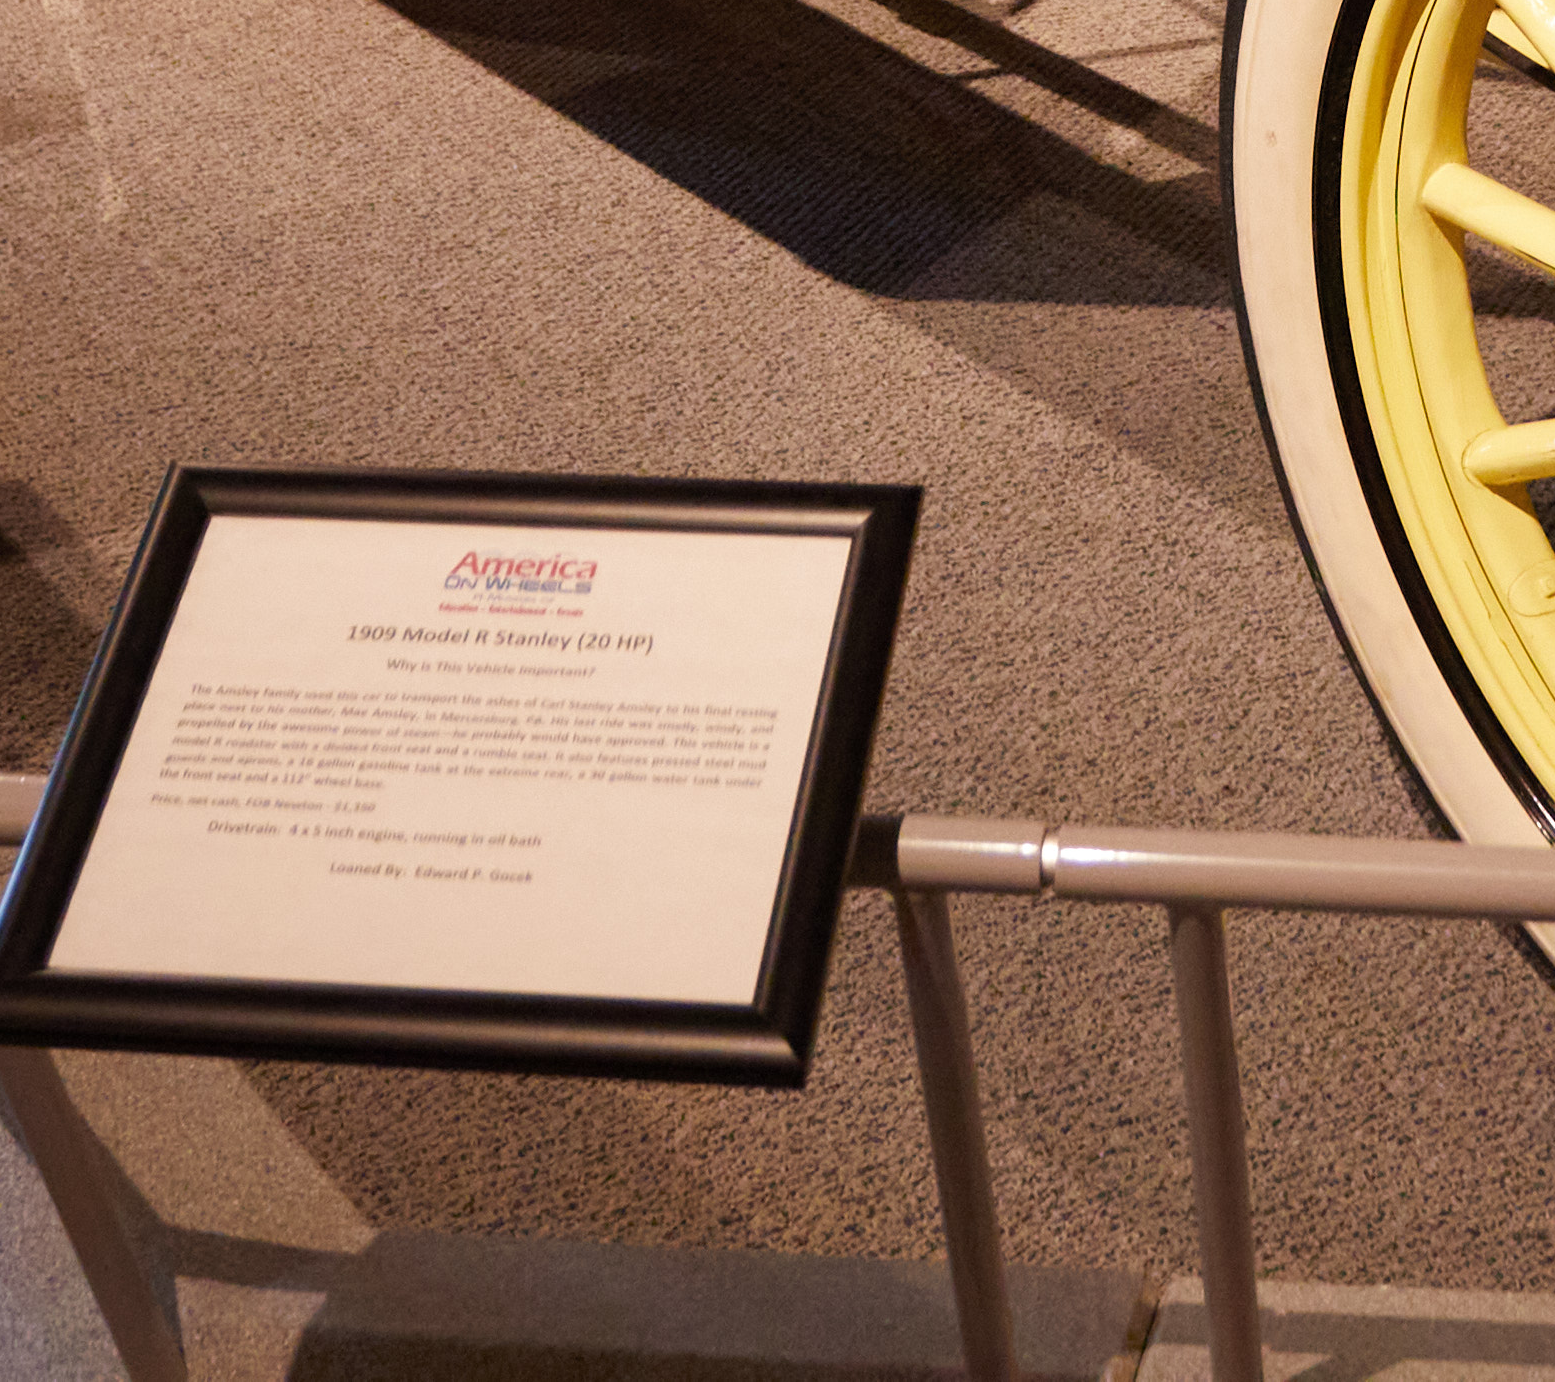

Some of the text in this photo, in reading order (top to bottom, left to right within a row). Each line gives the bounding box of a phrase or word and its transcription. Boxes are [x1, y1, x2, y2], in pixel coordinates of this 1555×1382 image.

[452, 549, 600, 579] America
[443, 574, 593, 594] ON WHEELS
[349, 624, 654, 655] 1909 Model R Stanley (20 HP)
[385, 658, 417, 673] Why
[437, 660, 463, 672] This
[466, 661, 516, 674] Vehicle
[191, 683, 213, 694] The
[262, 686, 301, 700] family
[337, 689, 359, 700] this
[400, 691, 458, 707] transport
[461, 694, 482, 705] the
[486, 695, 521, 707] ashes
[704, 704, 733, 716] final
[182, 699, 216, 713] place
[220, 700, 247, 712] next
[267, 702, 285, 714] his
[629, 720, 652, 729] was
[751, 722, 774, 734] and
[176, 715, 236, 731] propelled
[257, 719, 278, 730] the
[282, 723, 339, 733] awesome
[471, 728, 526, 743] probably
[531, 730, 569, 743] would
[572, 732, 602, 744] have
[674, 736, 697, 748] This
[702, 737, 745, 750] vehicle
[172, 733, 212, 745] model
[226, 735, 277, 748] roadster
[281, 737, 309, 749] with
[324, 739, 369, 752] divided
[371, 741, 402, 753] front
[406, 742, 431, 755] seat
[435, 744, 459, 756] and
[705, 755, 735, 768] steel
[159, 767, 180, 778] the
[182, 768, 214, 780] front
[216, 769, 243, 781] seat
[245, 770, 269, 782] and
[314, 773, 352, 786] wheel
[211, 752, 234, 764] and
[316, 756, 355, 772] gallon
[358, 758, 410, 774] gasoline
[415, 761, 442, 773] tank
[463, 763, 484, 775] the
[489, 764, 540, 777] extreme
[608, 769, 648, 784] gallon
[652, 771, 688, 783] water
[693, 772, 721, 785] tank
[726, 774, 763, 787] under
[207, 819, 282, 835] Drivetrain:
[324, 825, 355, 839] inch
[357, 826, 412, 844] engine,
[412, 829, 469, 847] running
[488, 832, 507, 846] oil
[508, 833, 543, 847] bath
[329, 862, 382, 876] Loaned
[414, 866, 469, 880] Edward
